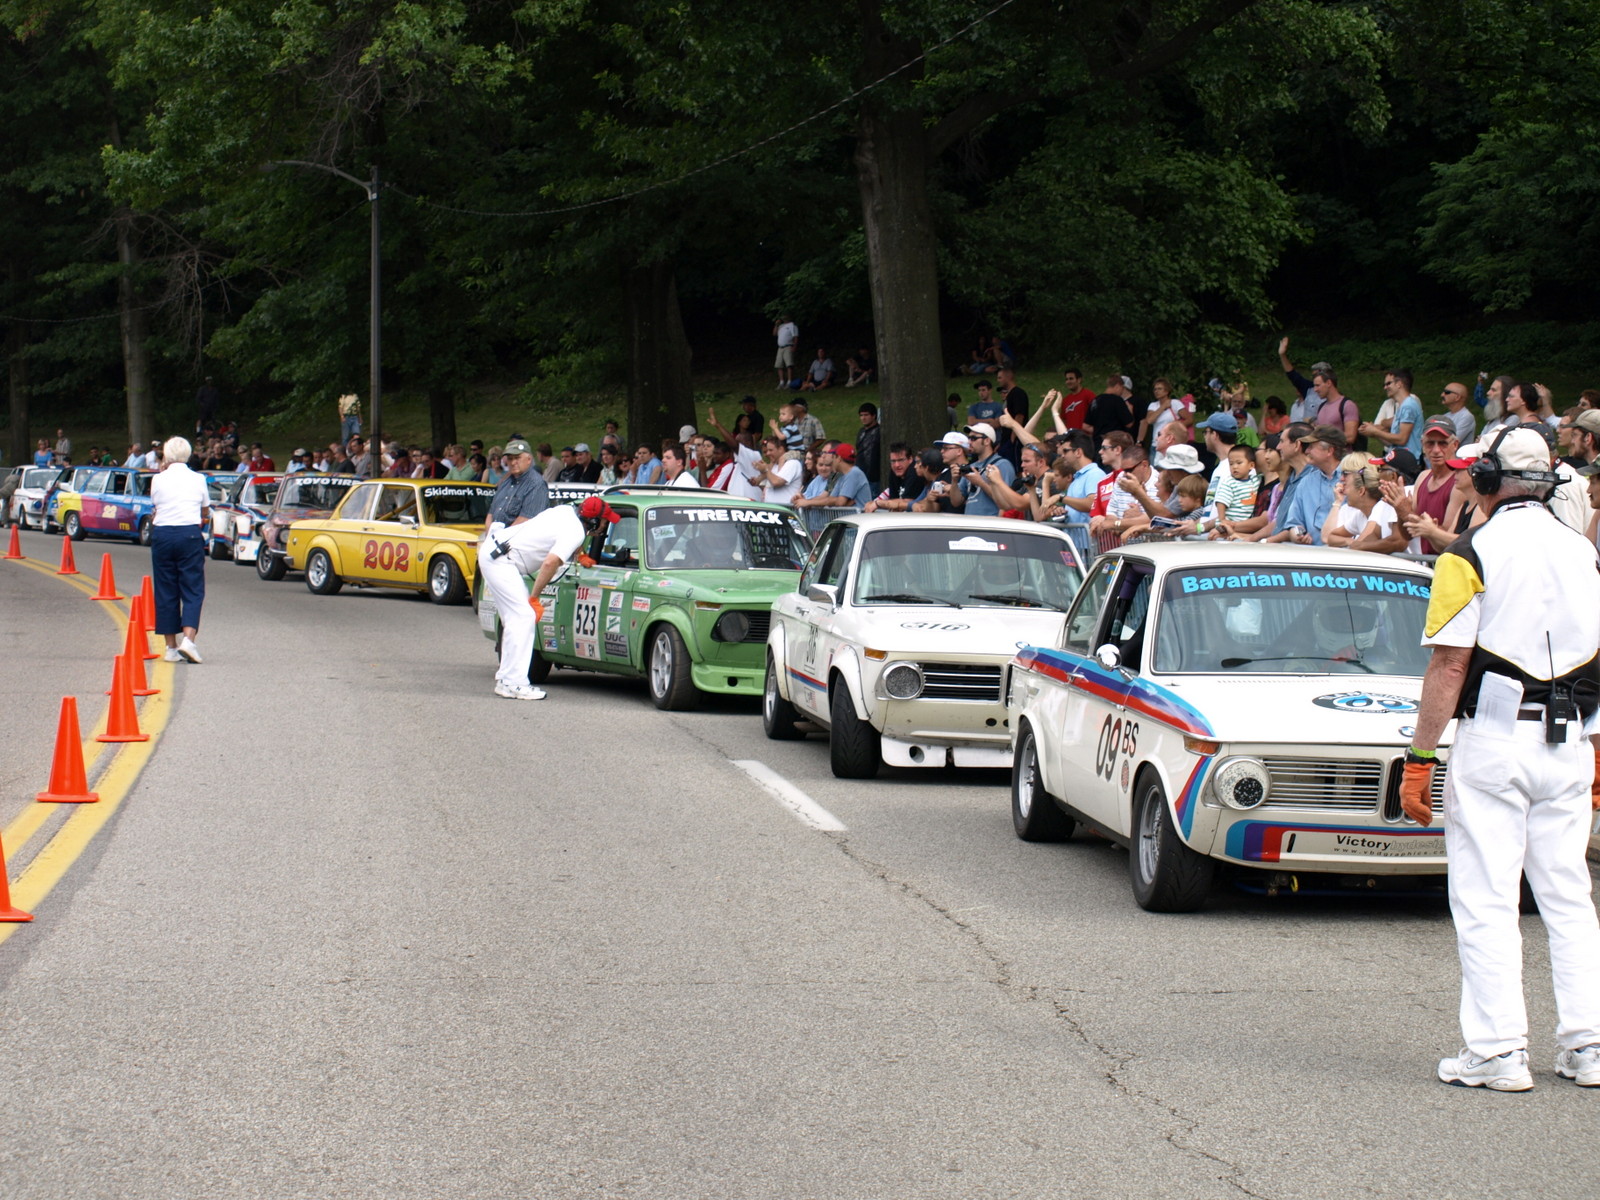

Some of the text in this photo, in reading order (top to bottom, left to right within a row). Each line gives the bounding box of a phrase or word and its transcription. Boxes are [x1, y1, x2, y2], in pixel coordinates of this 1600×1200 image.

[424, 487, 474, 497] Skidmark
[683, 509, 730, 522] TIRE
[731, 509, 783, 525] RACK
[364, 539, 410, 573] 202
[1181, 571, 1431, 599] Bavarian Motor Works
[575, 603, 597, 637] 523
[1096, 713, 1122, 782] 09
[1121, 719, 1140, 758] BS
